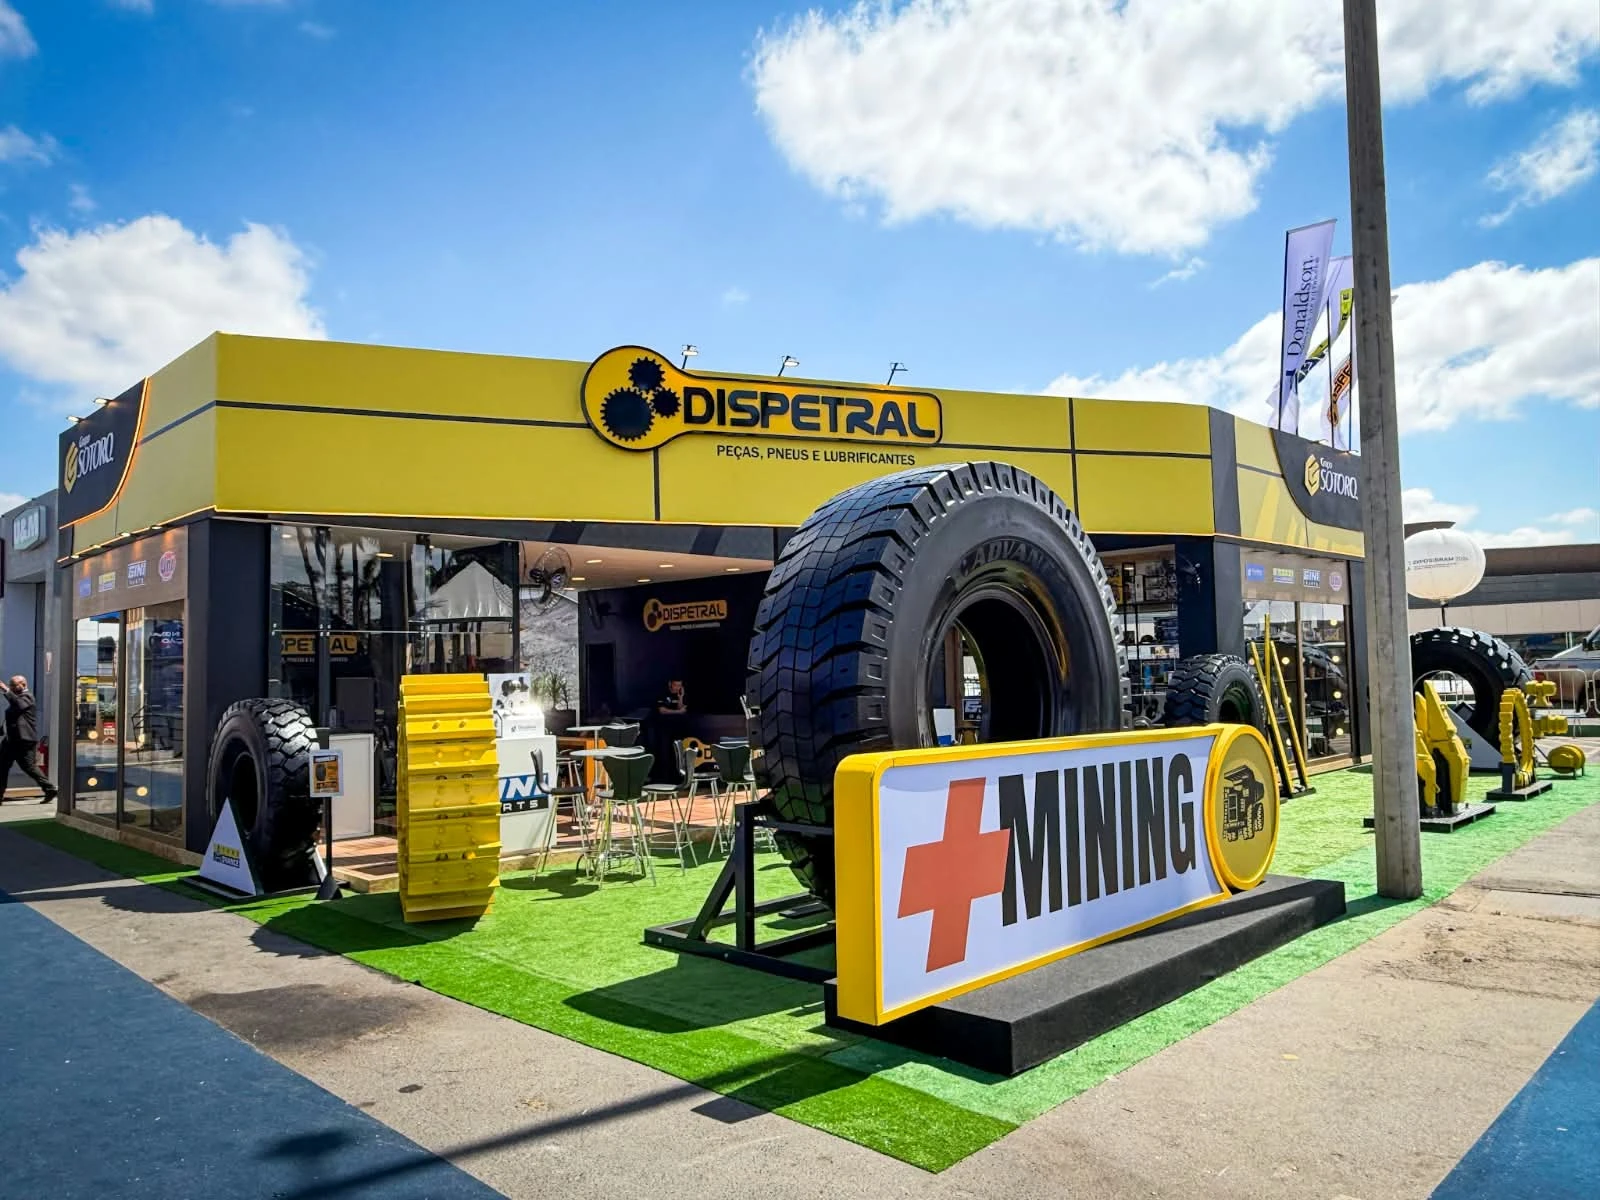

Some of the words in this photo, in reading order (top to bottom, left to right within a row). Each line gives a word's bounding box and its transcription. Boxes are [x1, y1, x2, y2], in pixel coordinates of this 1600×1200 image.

[1287, 259, 1313, 356] Donaldson
[683, 386, 936, 439] DISPETRAL
[716, 445, 763, 461] PEÇAS,
[767, 447, 809, 461] PNEUS
[813, 450, 820, 462] E
[824, 451, 916, 466] LUBRIFICANTES
[1320, 469, 1359, 500] SOTORQ
[663, 603, 724, 620] DISPETRAL
